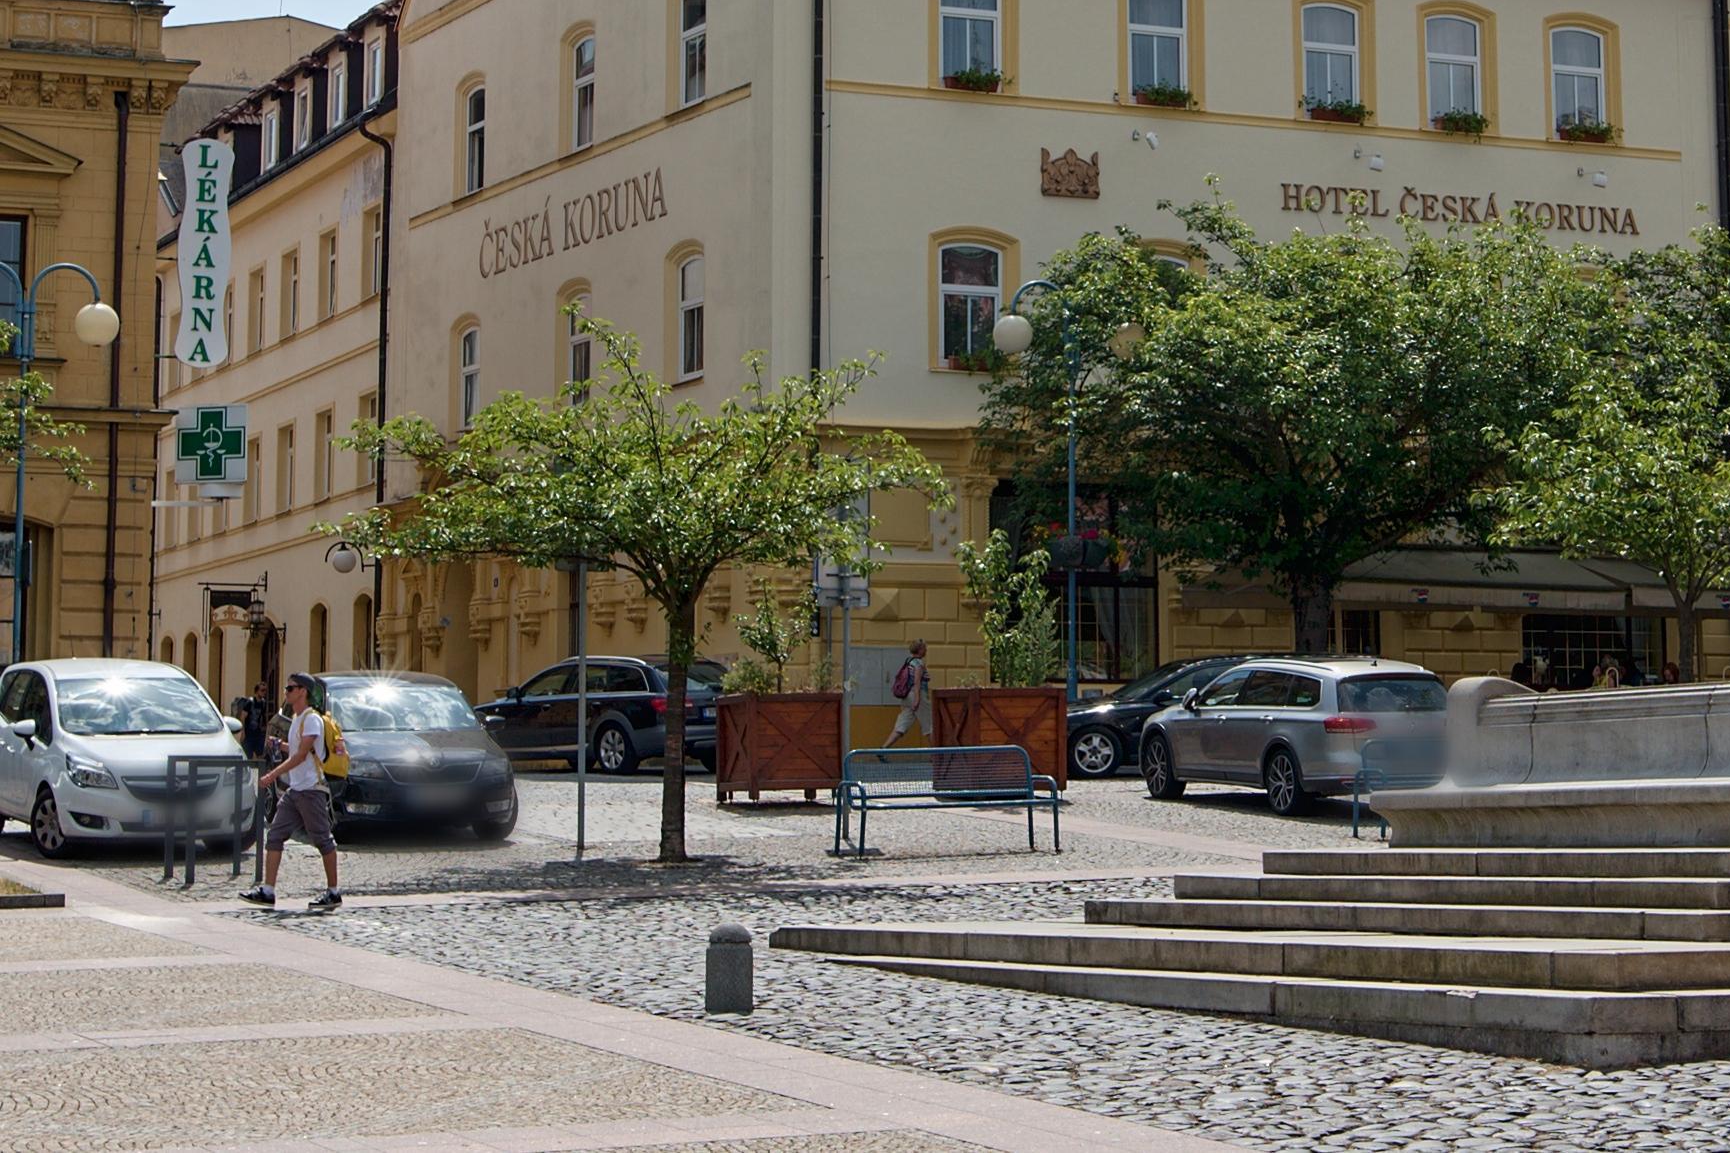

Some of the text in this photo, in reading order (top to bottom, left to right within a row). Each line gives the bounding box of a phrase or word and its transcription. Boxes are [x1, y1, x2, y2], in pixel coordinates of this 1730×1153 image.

[188, 144, 219, 362] LÉKÁRNA
[479, 166, 668, 279] ČESKÁ KORUNA
[1281, 183, 1640, 235] HOTEL ČESKÁ KORUNA
